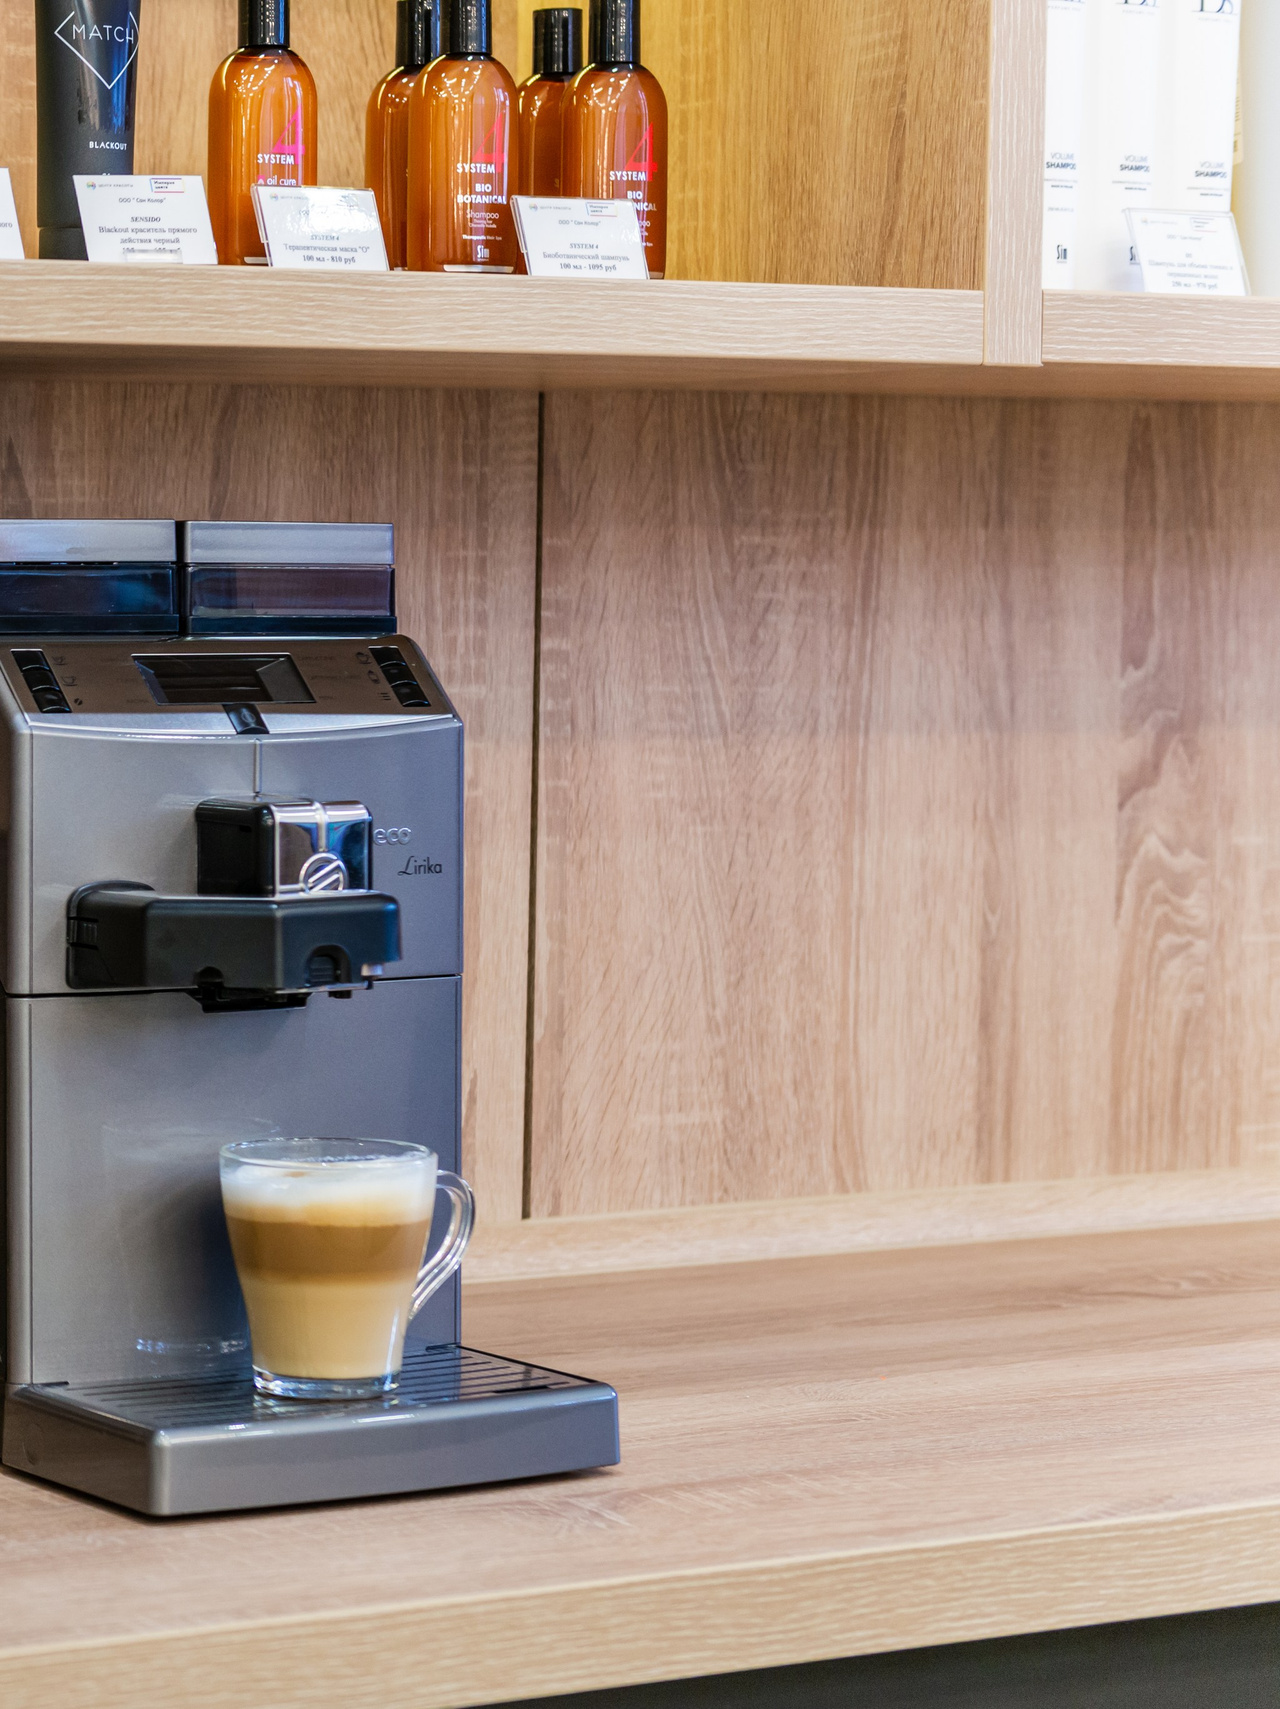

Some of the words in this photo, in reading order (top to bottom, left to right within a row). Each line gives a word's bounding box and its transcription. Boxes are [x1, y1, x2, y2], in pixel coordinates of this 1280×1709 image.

[73, 24, 134, 44] MATCH
[89, 141, 127, 151] BLACKOUT
[257, 154, 295, 165] SYSTEM
[457, 163, 495, 174] SYSTEM
[267, 175, 277, 185] oil
[279, 178, 297, 186] cure
[610, 171, 646, 181] SYSTEM
[475, 184, 492, 192] BIO
[457, 195, 507, 205] BOTANICAL
[627, 191, 643, 200] BIO
[634, 202, 657, 211] NICAL
[467, 209, 499, 221] Shampoo
[98, 226, 129, 234] Blackout
[131, 227, 167, 235] краситель
[168, 227, 198, 235] прямого
[120, 237, 152, 245] действия
[153, 237, 180, 246] черный
[283, 243, 338, 253] Терапевтическая
[344, 256, 356, 265] руб
[543, 251, 600, 261] Биоботанический
[605, 264, 617, 272] руб
[373, 827, 412, 845] eco
[397, 855, 443, 876] Lirika
